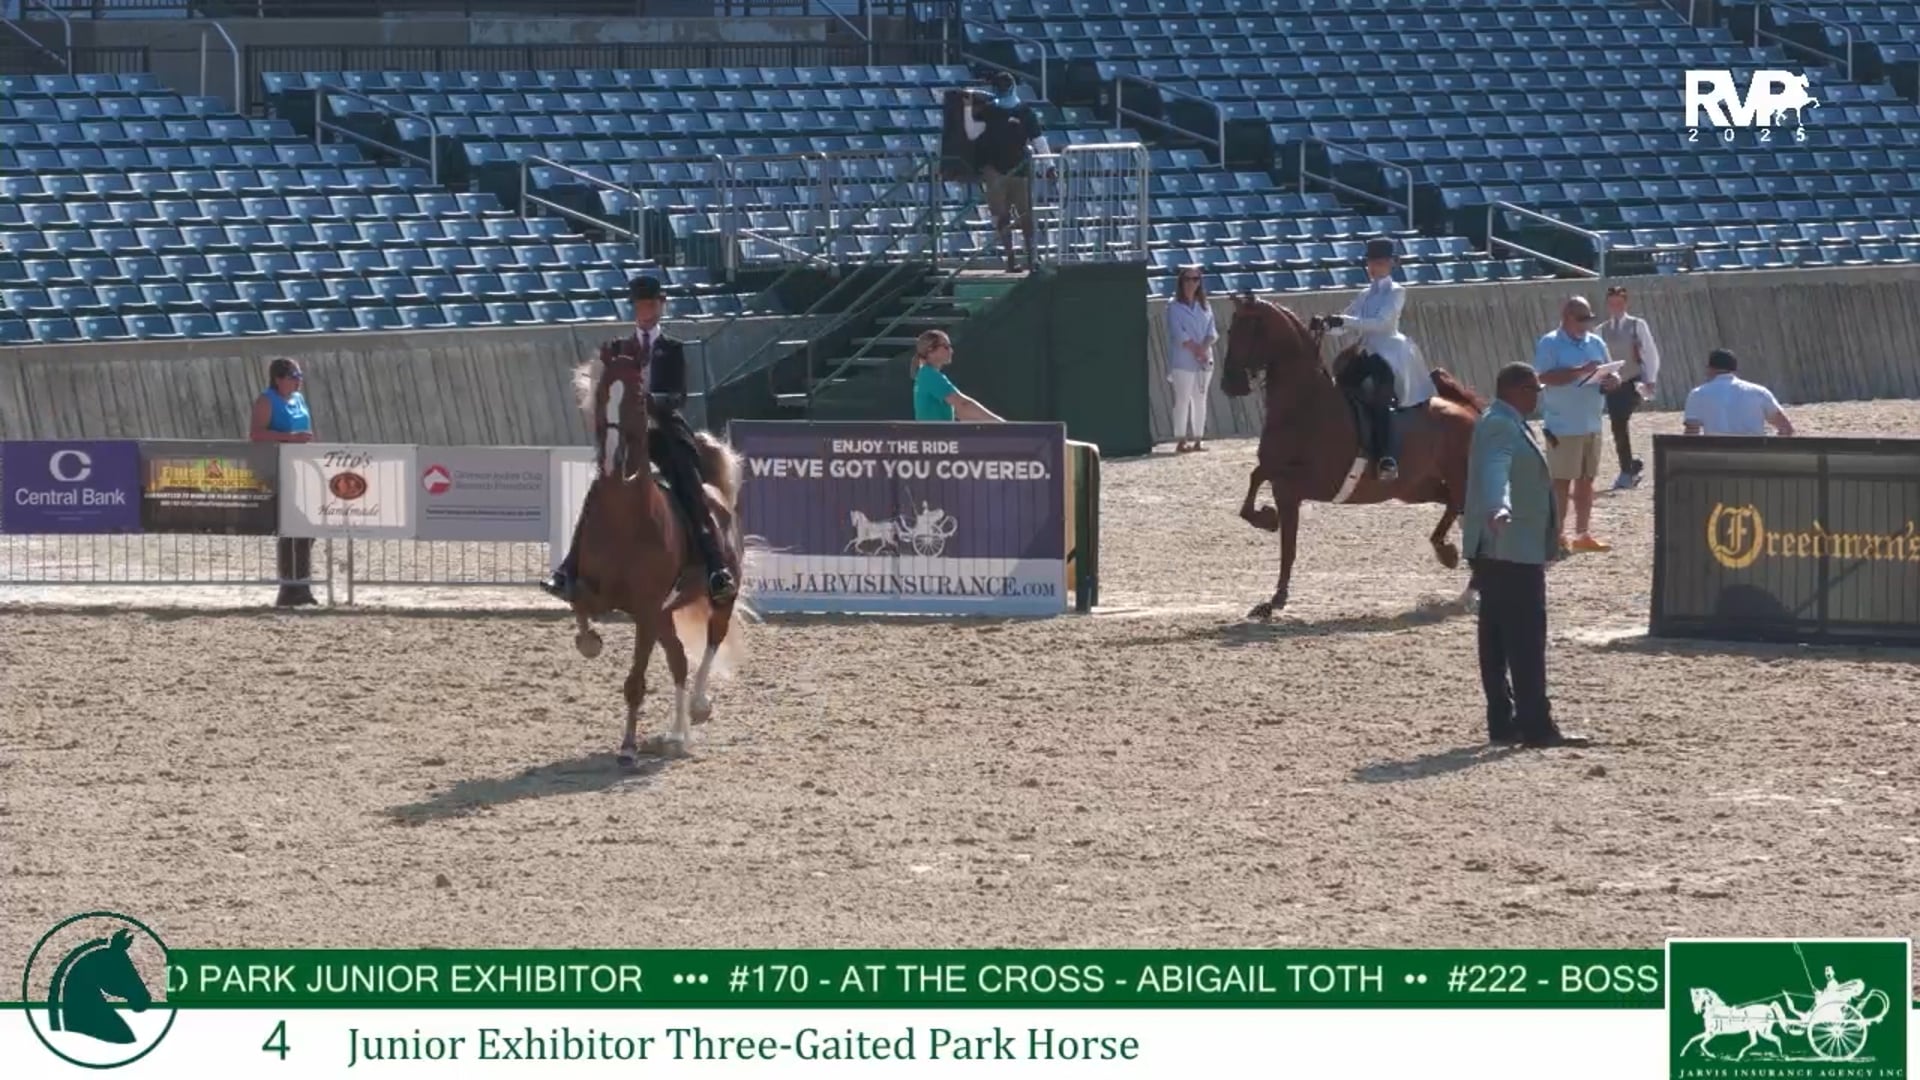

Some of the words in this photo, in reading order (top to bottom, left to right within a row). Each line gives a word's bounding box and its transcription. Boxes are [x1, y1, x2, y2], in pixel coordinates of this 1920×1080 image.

[832, 439, 883, 454] ENJOY
[887, 440, 919, 454] THE
[921, 440, 959, 455] RIDE
[323, 449, 374, 469] Tito's
[749, 458, 823, 478] WE'VE
[829, 459, 877, 478] GOT
[882, 459, 930, 479] YOU
[936, 460, 1051, 480] COVERED.
[15, 487, 77, 505] Central
[82, 487, 126, 505] Bank
[1707, 502, 1920, 569] Freedman's
